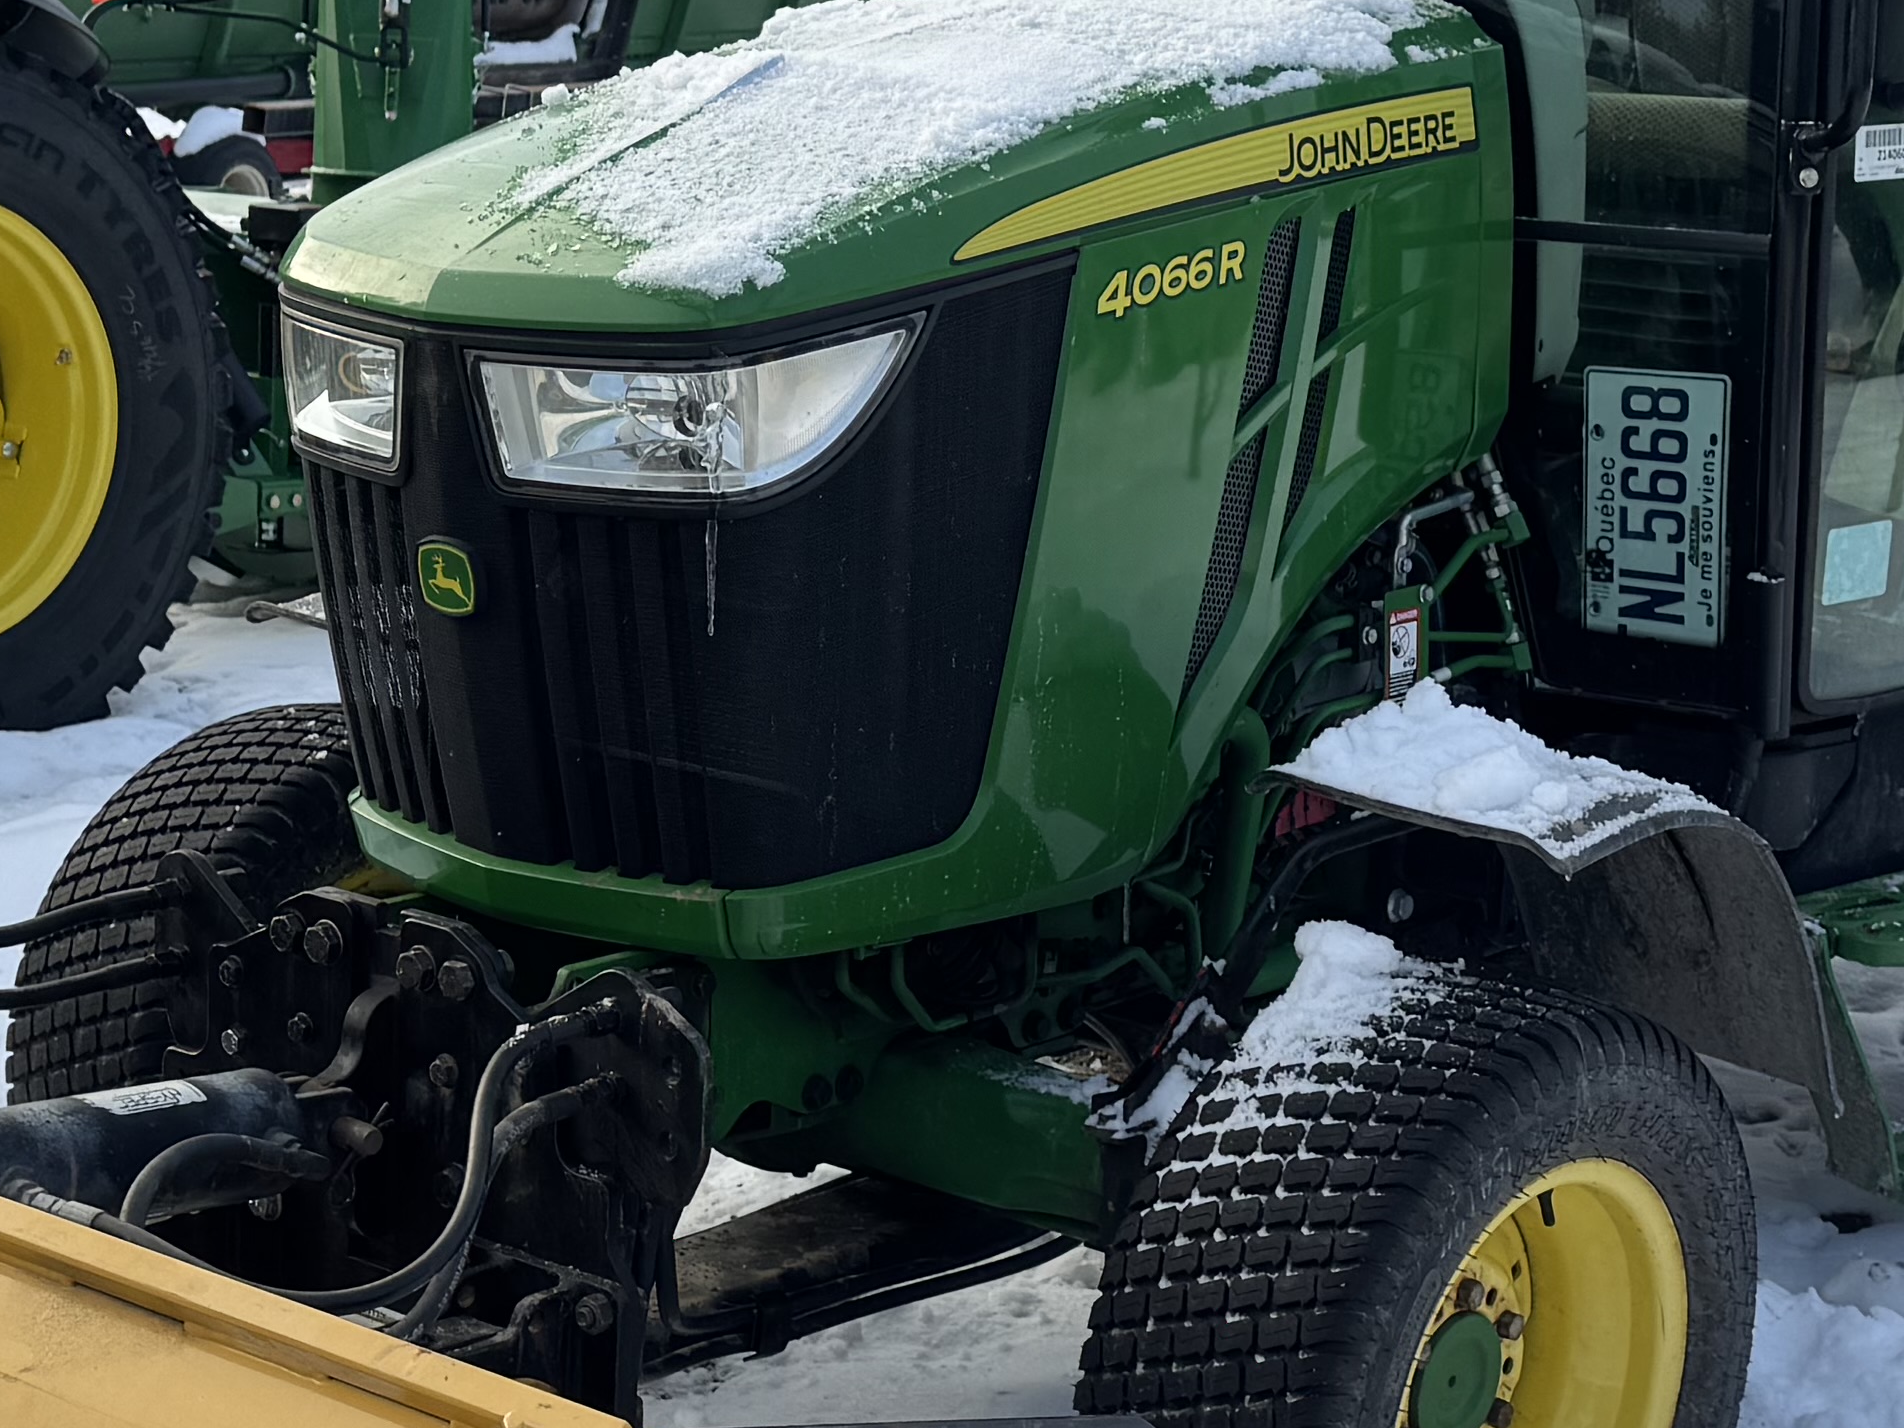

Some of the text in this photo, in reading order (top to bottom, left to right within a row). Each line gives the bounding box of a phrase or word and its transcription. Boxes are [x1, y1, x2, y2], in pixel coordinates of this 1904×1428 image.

[1278, 110, 1457, 178] JOHN DEERE
[76, 159, 183, 343] TYRES
[1594, 456, 1616, 554] Québec
[1617, 385, 1690, 634] NL5668
[1697, 448, 1716, 613] Je me souviens
